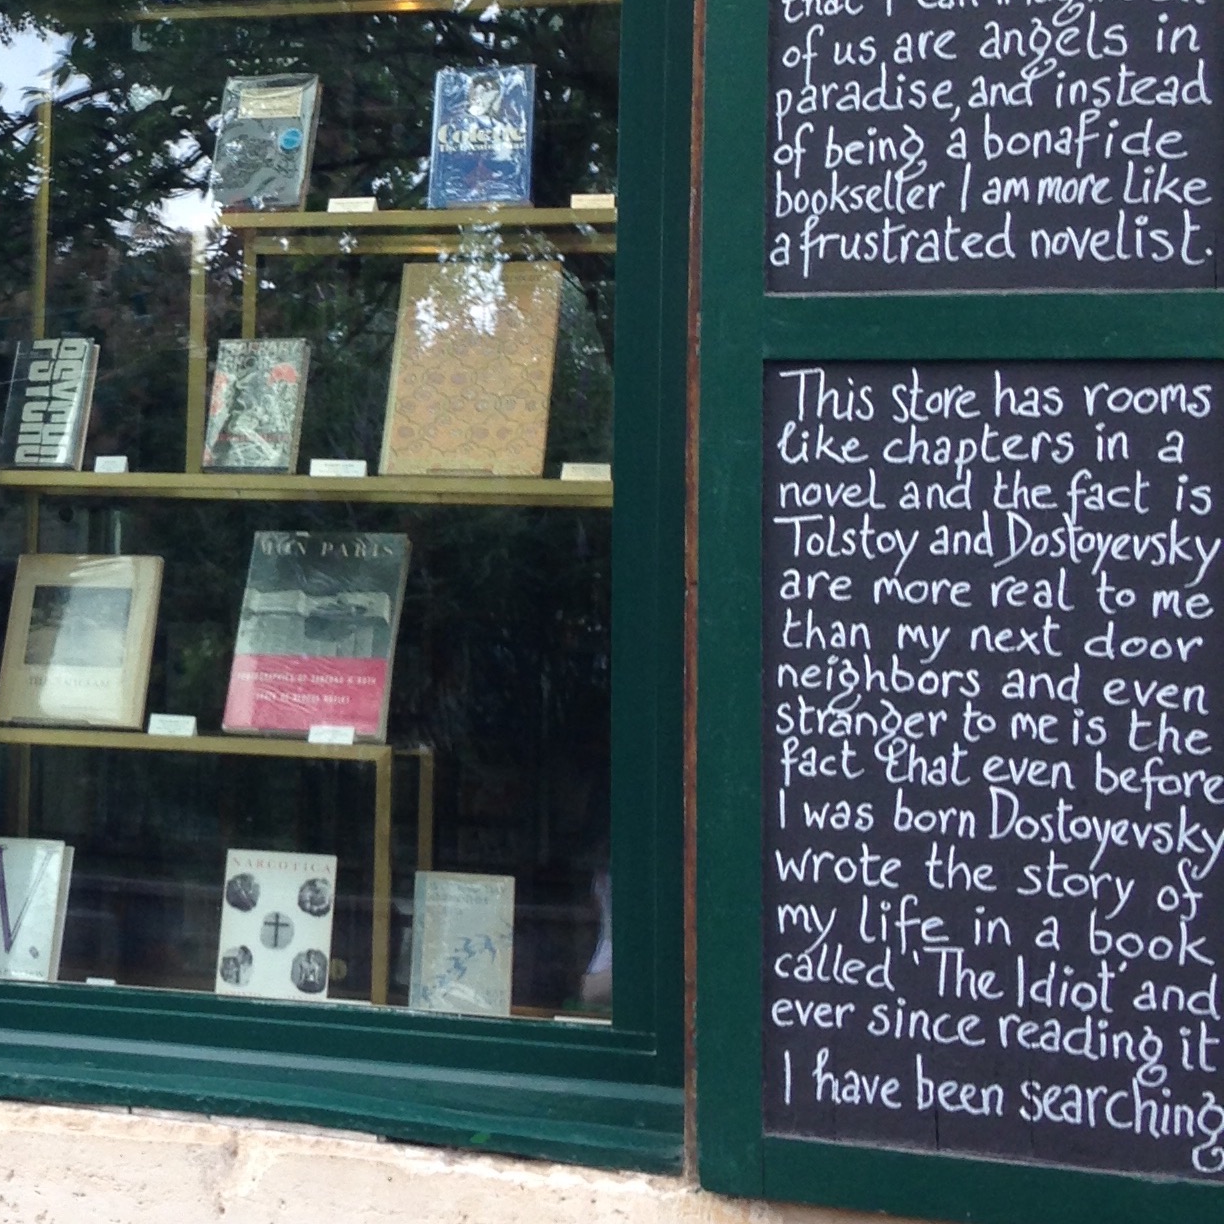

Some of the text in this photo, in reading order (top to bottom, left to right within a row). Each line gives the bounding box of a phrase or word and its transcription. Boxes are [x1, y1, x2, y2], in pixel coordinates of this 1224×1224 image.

[782, 24, 824, 84] of
[894, 30, 957, 64] are
[979, 10, 1128, 79] angels
[1157, 13, 1200, 54] in
[776, 58, 1212, 141] paradise, and instead
[774, 108, 1188, 181] of being a bonafide
[776, 169, 945, 218] bookseller
[982, 177, 1029, 204] am
[1037, 173, 1112, 205] more
[770, 209, 1212, 278] a frustrated novelist.
[780, 368, 1212, 423] This store has rooms
[777, 421, 1184, 481] like chapters in a
[780, 468, 1211, 525] novel and the fact is
[321, 541, 394, 558] PARIS
[773, 510, 1221, 587] Tolstoy and Dostoyevsky
[783, 608, 1203, 664] than my next door
[778, 653, 1208, 714] neighbors and even
[781, 736, 1224, 811] fact that even before
[232, 857, 332, 875] NARCOTICA
[779, 785, 1224, 880] I was born Dostoyevsky
[775, 841, 1203, 921] wrote the story of
[778, 894, 1215, 965] my life in a book
[774, 943, 895, 991] called
[1133, 973, 1220, 1020] and
[772, 997, 1220, 1090] ever since reading it
[784, 1047, 1224, 1176] I have been searching
